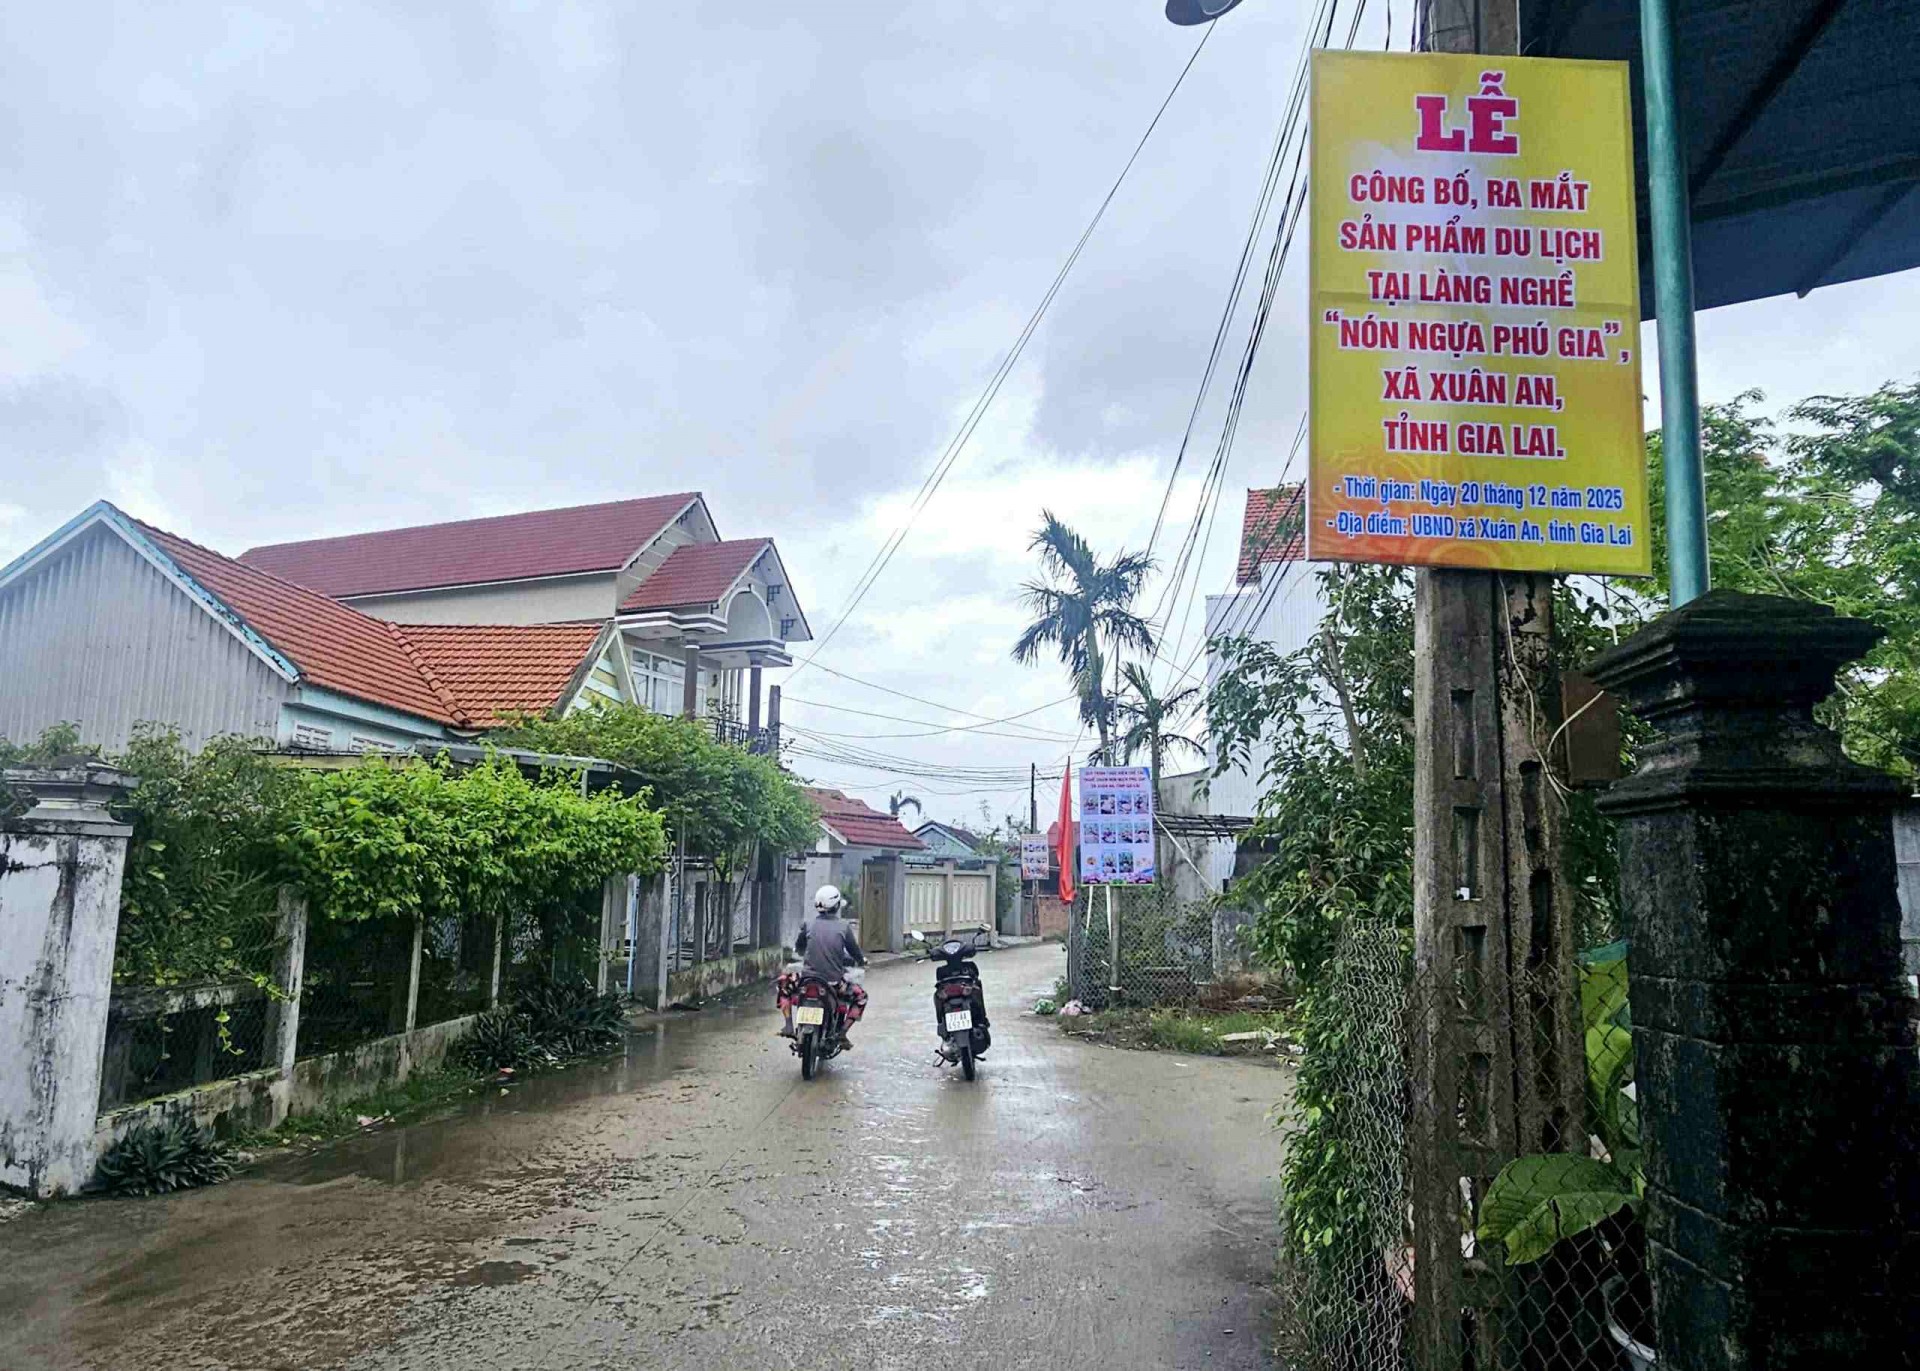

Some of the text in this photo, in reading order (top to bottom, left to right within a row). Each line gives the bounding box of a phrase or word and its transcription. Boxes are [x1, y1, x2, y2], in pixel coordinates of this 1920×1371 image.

[1417, 72, 1518, 154] LỄ
[1351, 169, 1589, 210] CÔNG BỐ, RA MẮT
[1341, 214, 1600, 263] SẢN PHẨM DU LỊCH
[1368, 268, 1574, 307] TẠI LÀNG NGHỀ
[1410, 321, 1485, 358] NGỰA
[1494, 322, 1548, 355] PHÚ
[1384, 366, 1563, 409] XÃ XUÂN AN,
[1384, 412, 1564, 457] TỈNH GIA LAI.
[1345, 477, 1376, 499] Thời
[1381, 482, 1416, 503] gian:
[1420, 483, 1457, 506] Ngày
[1461, 484, 1479, 503] 20
[1484, 484, 1524, 510] tháng
[1529, 486, 1545, 506] 12
[1551, 488, 1581, 508] năm
[1587, 488, 1622, 509] 2025
[1337, 512, 1362, 537] Địa
[1368, 510, 1407, 535] điểm:
[1412, 514, 1453, 536] UBND
[1459, 518, 1478, 538] xã
[1479, 517, 1515, 540] Xuân
[1520, 521, 1544, 545] An,
[1549, 520, 1575, 543] tỉnh
[1581, 522, 1604, 544] Gia
[1609, 524, 1631, 545] Lai
